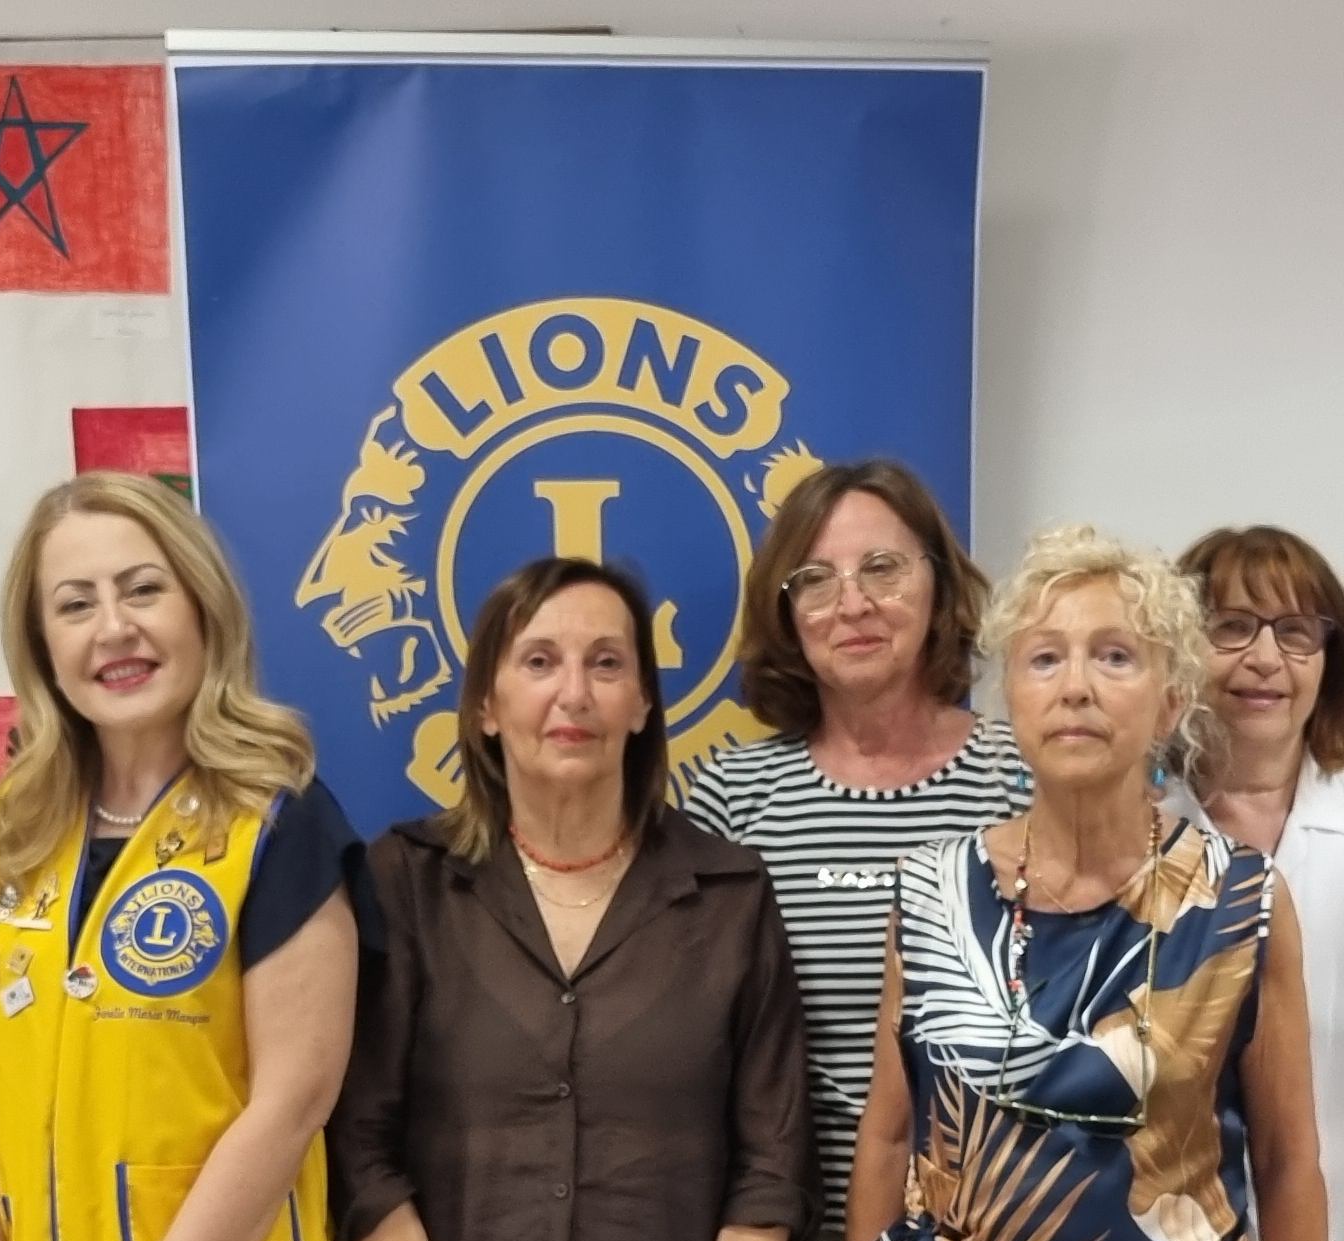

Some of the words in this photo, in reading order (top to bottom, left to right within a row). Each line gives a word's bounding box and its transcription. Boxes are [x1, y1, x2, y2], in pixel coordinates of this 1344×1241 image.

[419, 312, 765, 438] LIONS
[141, 883, 200, 908] LIONS
[143, 906, 177, 946] L
[120, 953, 191, 977] INTERNATIONAL
